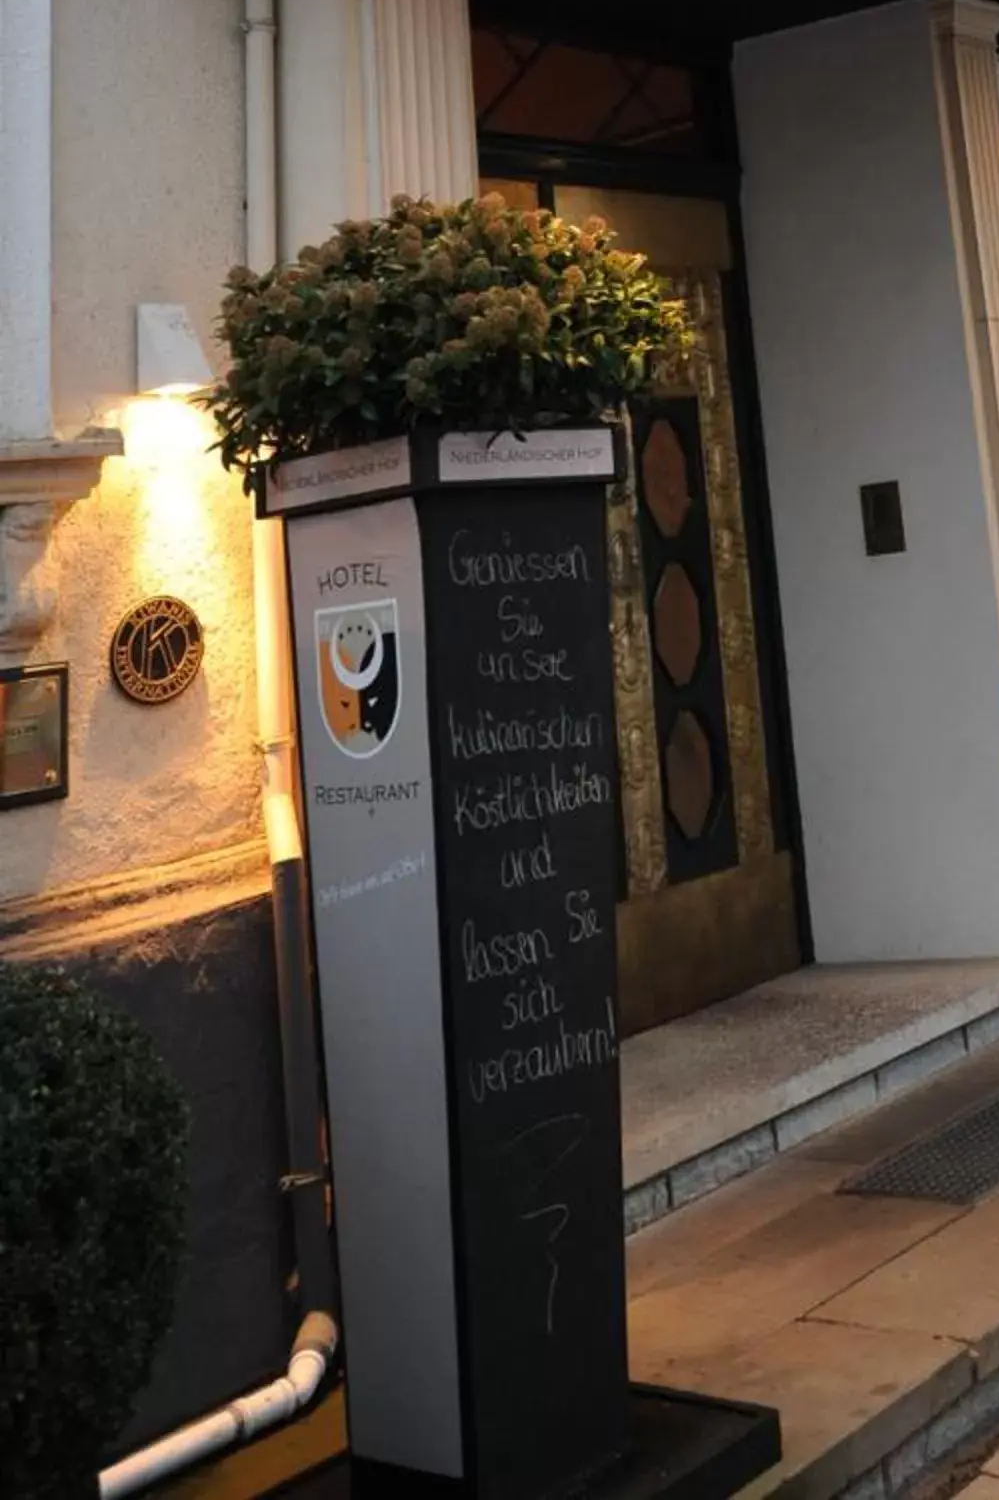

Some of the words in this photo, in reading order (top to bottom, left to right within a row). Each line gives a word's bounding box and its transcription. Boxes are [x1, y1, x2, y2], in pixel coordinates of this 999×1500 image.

[317, 561, 389, 595] HOTEL
[448, 528, 592, 587] Geniessen
[497, 595, 544, 643] Sie
[314, 780, 421, 806] RESTAURANT
[501, 831, 558, 888] und
[564, 889, 603, 943] Sie
[502, 975, 564, 1030] sich
